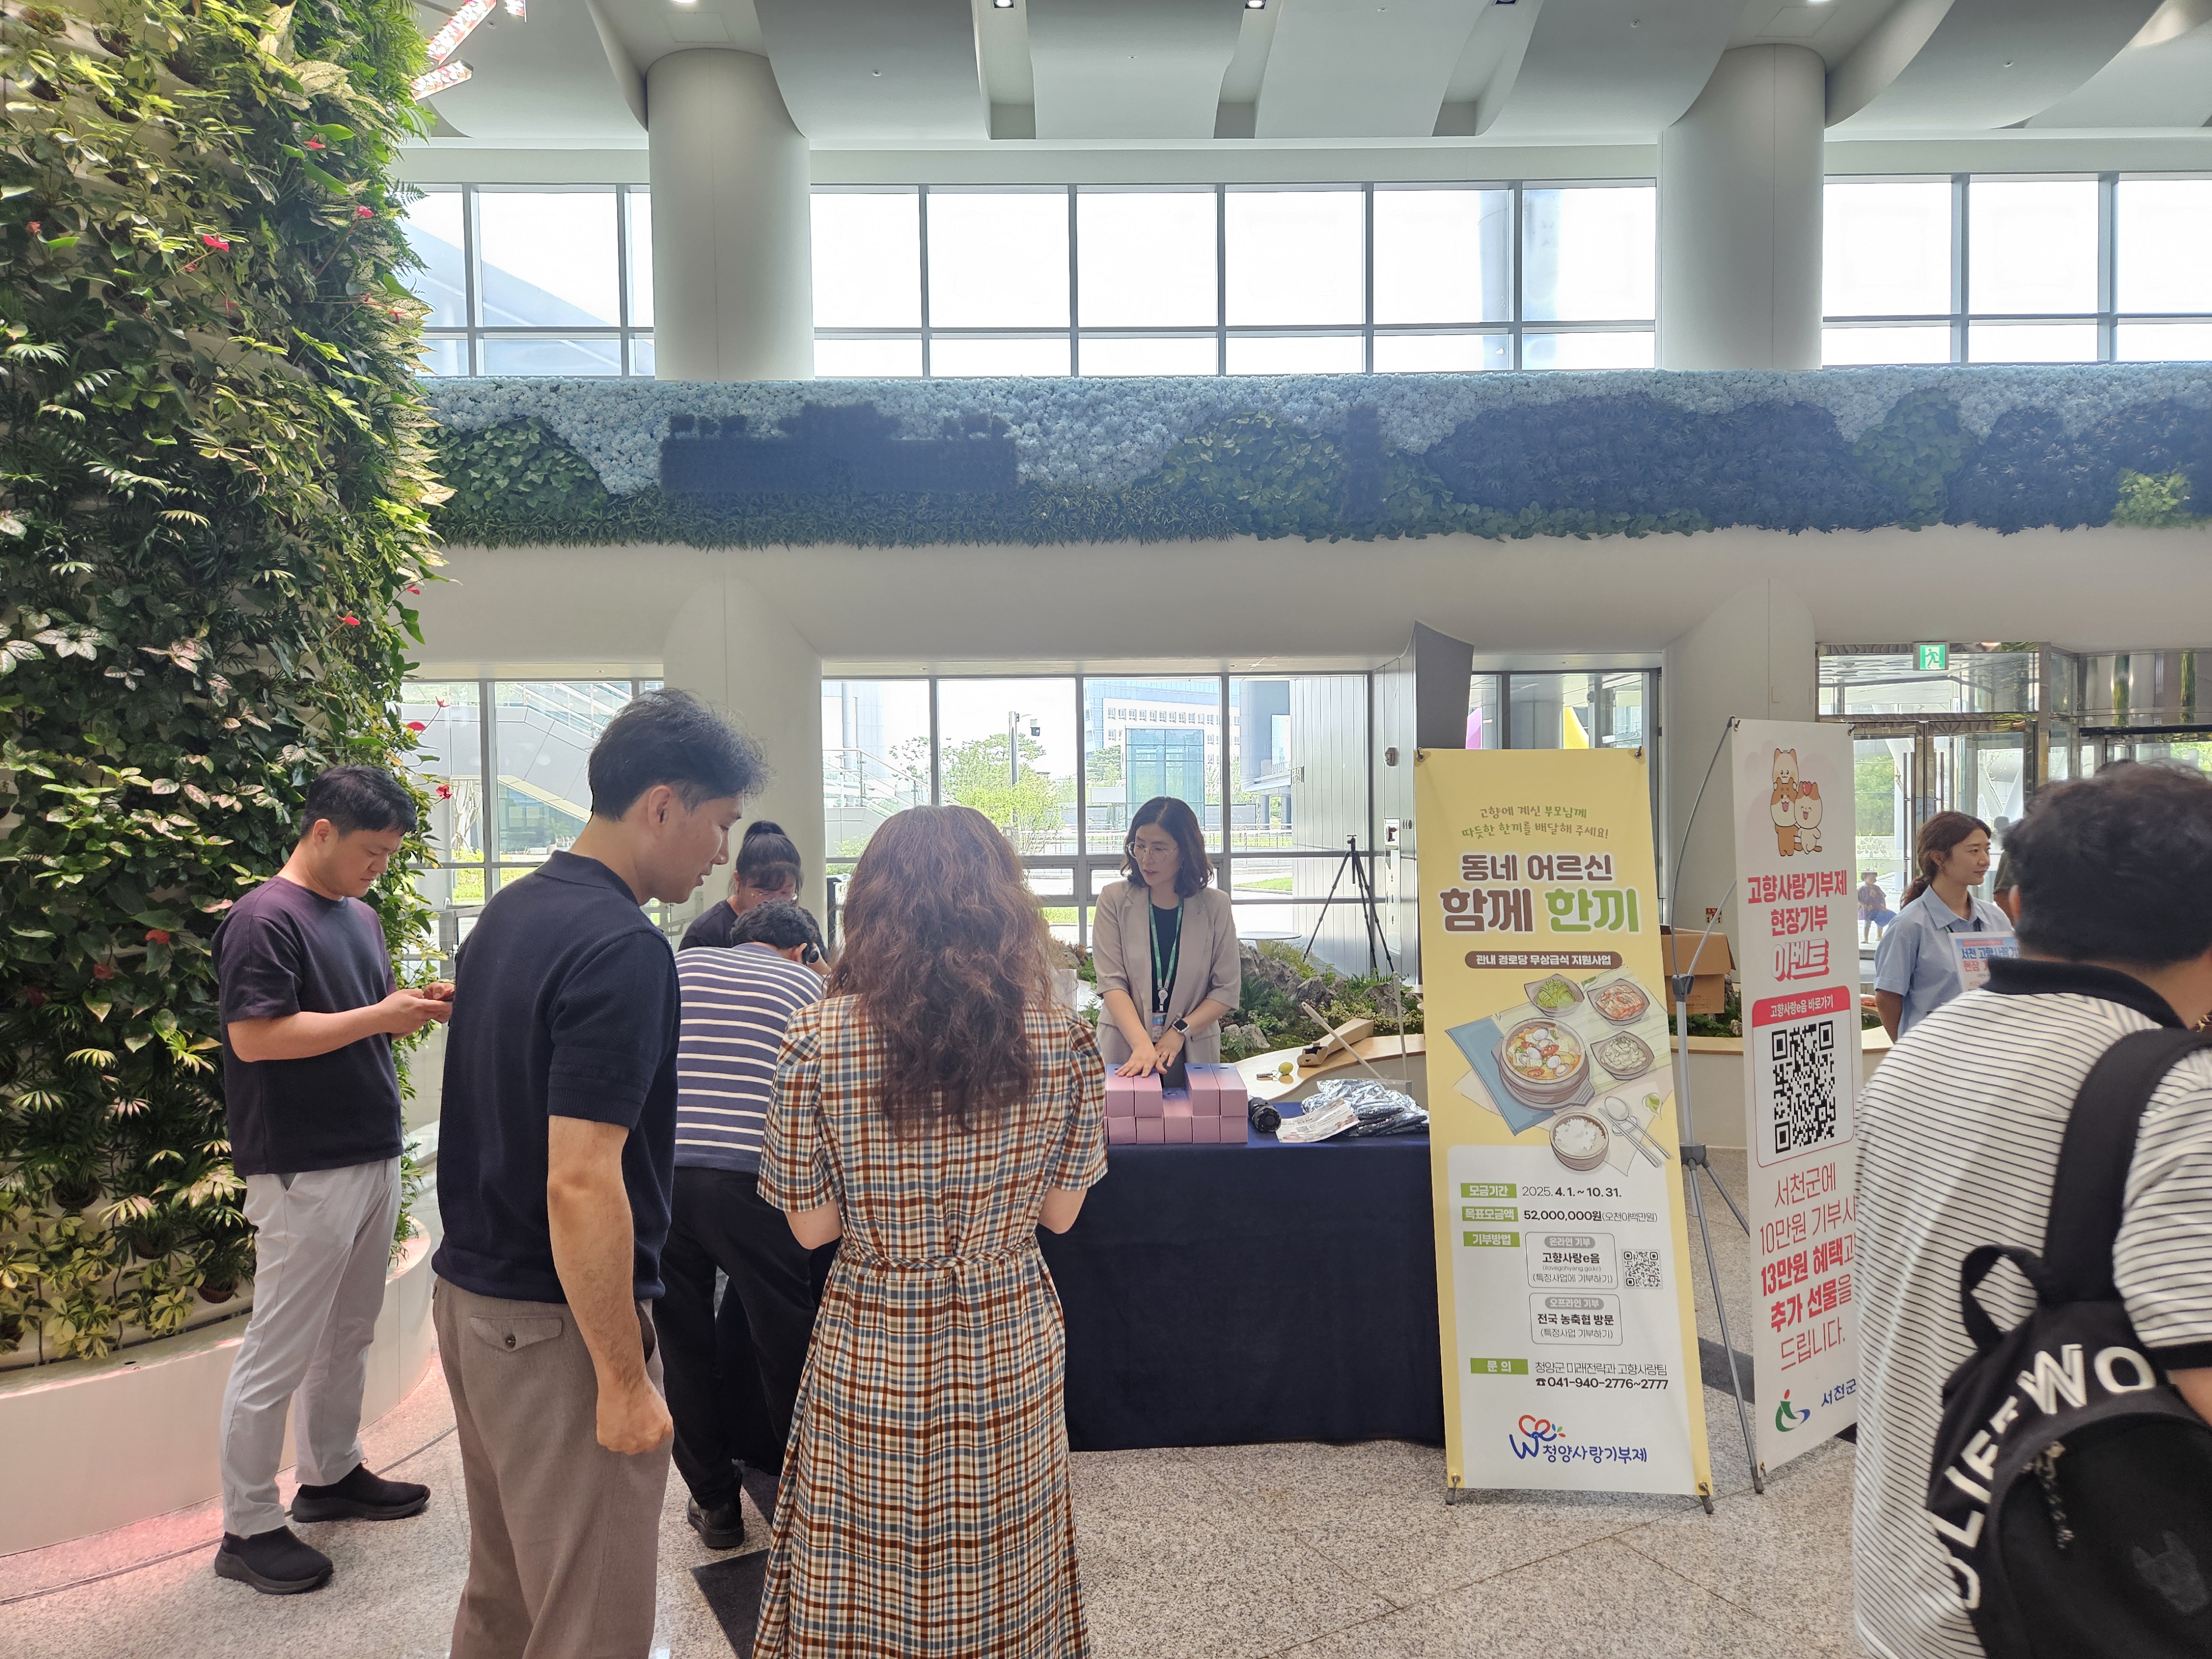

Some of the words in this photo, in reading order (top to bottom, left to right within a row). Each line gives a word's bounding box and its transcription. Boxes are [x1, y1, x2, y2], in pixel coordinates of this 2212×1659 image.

[1480, 806, 1514, 819] 고향에
[1517, 805, 1541, 817] 계신
[1545, 806, 1587, 818] 부모님께
[1462, 824, 1495, 839] 따듯한
[1498, 821, 1531, 836] 한끼를
[1535, 822, 1572, 835] 배달해
[1575, 825, 1609, 839] 주세요!
[1462, 854, 1517, 881] 동네
[1527, 854, 1613, 881] 어르신
[1748, 869, 1848, 904] 고향사랑기부제
[1439, 888, 1533, 932] 함께
[1545, 888, 1639, 932] 한끼
[1771, 905, 1828, 937] 현장기부
[1476, 954, 1496, 965] 관내
[1498, 954, 1528, 965] 경로당
[1530, 954, 1569, 966] 무상급식
[1572, 955, 1611, 966] 지원사업
[1771, 938, 1829, 981] 이벤트
[1770, 999, 1807, 1018] 고향사랑e음
[1808, 994, 1834, 1011] 바로가기
[1469, 1185, 1509, 1197] 모금기간
[1522, 1186, 1553, 1196] 2025.
[1555, 1187, 1566, 1197] 4.
[1567, 1187, 1575, 1197] 1.
[1587, 1187, 1604, 1197] 10.
[1605, 1188, 1622, 1197] 31.
[1775, 1162, 1837, 1208] 서천군에
[1465, 1208, 1514, 1220] 목표모금액
[1760, 1211, 1806, 1256] 10만원
[1812, 1194, 1856, 1235] 기부시
[1473, 1234, 1511, 1245] 기부방법
[1549, 1237, 1573, 1246] 온라인
[1575, 1238, 1591, 1246] 기부
[1542, 1252, 1600, 1264] 고향사랑e음
[1533, 1274, 1576, 1282] (특정사업에
[1578, 1274, 1613, 1284] 기부하기)
[1761, 1250, 1808, 1297] 13만원
[1550, 1298, 1582, 1307] 오프라인
[1584, 1299, 1599, 1308] 기부
[1771, 1293, 1803, 1333] 추가
[1807, 1274, 1852, 1318] 선물을
[1537, 1313, 1558, 1324] 전국
[1561, 1313, 1591, 1325] 농축협
[1593, 1314, 1614, 1326] 방문
[1541, 1328, 1576, 1338] (특정사업
[1578, 1329, 1613, 1339] 기부하기)
[1781, 1316, 1845, 1371] 드립니다.
[1535, 1361, 1565, 1373] 청양군
[1567, 1362, 1616, 1375] 미래전략과
[1618, 1363, 1667, 1376] 고향사랑팀
[1821, 1378, 1856, 1407] 서천군
[1542, 1444, 1647, 1464] 청양사랑기부제
